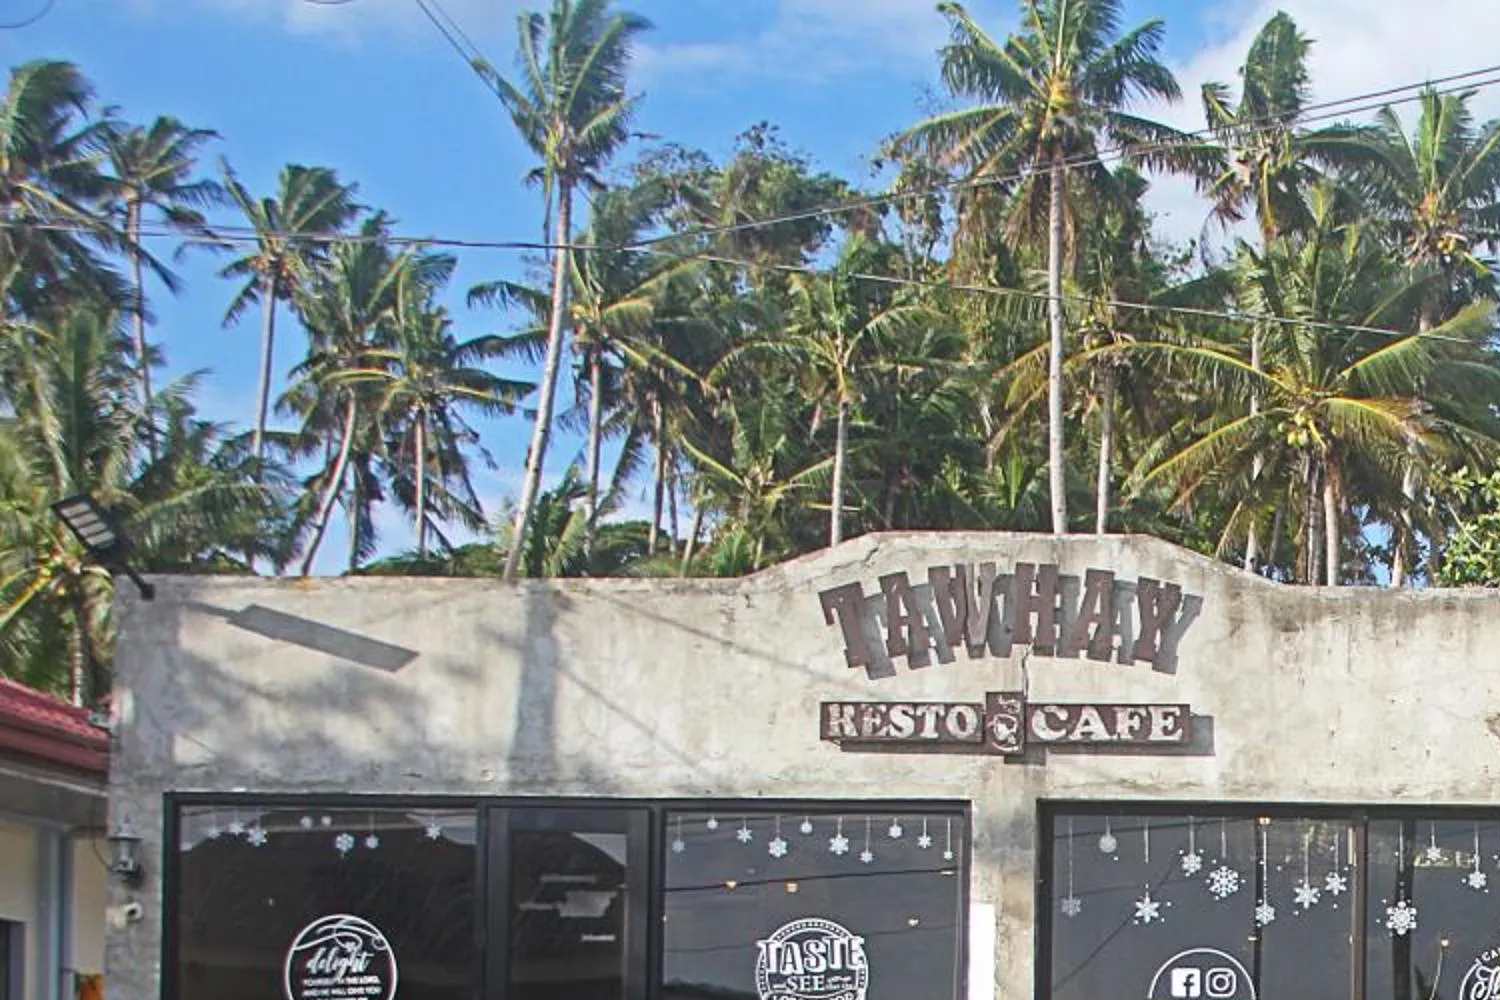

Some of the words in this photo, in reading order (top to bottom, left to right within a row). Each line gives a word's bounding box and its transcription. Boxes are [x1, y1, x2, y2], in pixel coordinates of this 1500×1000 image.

[818, 561, 1184, 668] TAWHAY
[827, 704, 977, 739] RESTO
[1031, 706, 1183, 741] CAFE
[306, 942, 374, 982] delight
[756, 936, 864, 975] TASTE
[787, 975, 825, 991] SEE
